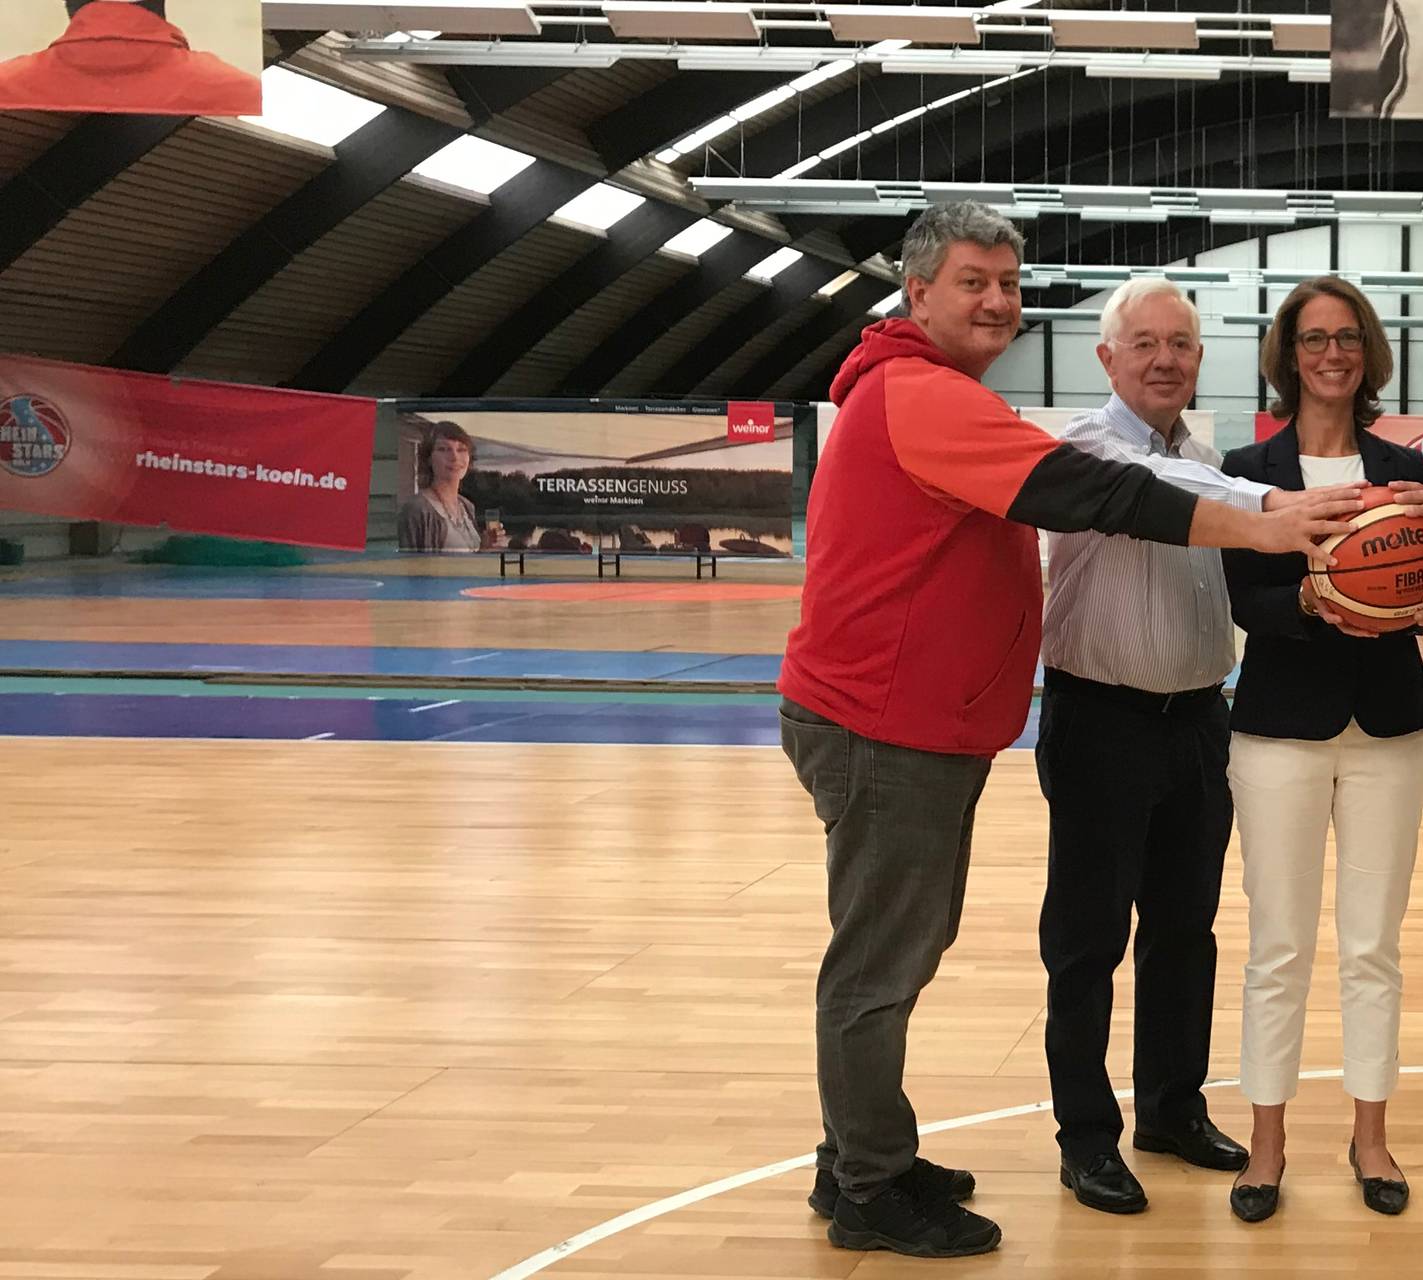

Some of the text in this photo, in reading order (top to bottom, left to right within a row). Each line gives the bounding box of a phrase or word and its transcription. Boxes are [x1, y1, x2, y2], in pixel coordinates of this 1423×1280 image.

[733, 419, 770, 433] weinor
[0, 427, 38, 441] HEIN
[13, 444, 65, 459] STARS
[136, 451, 347, 490] rheinstars-koeln.de
[537, 478, 688, 494] TERRASSENGENUSS
[610, 496, 644, 505] Markisen
[1395, 569, 1423, 588] FIBA
